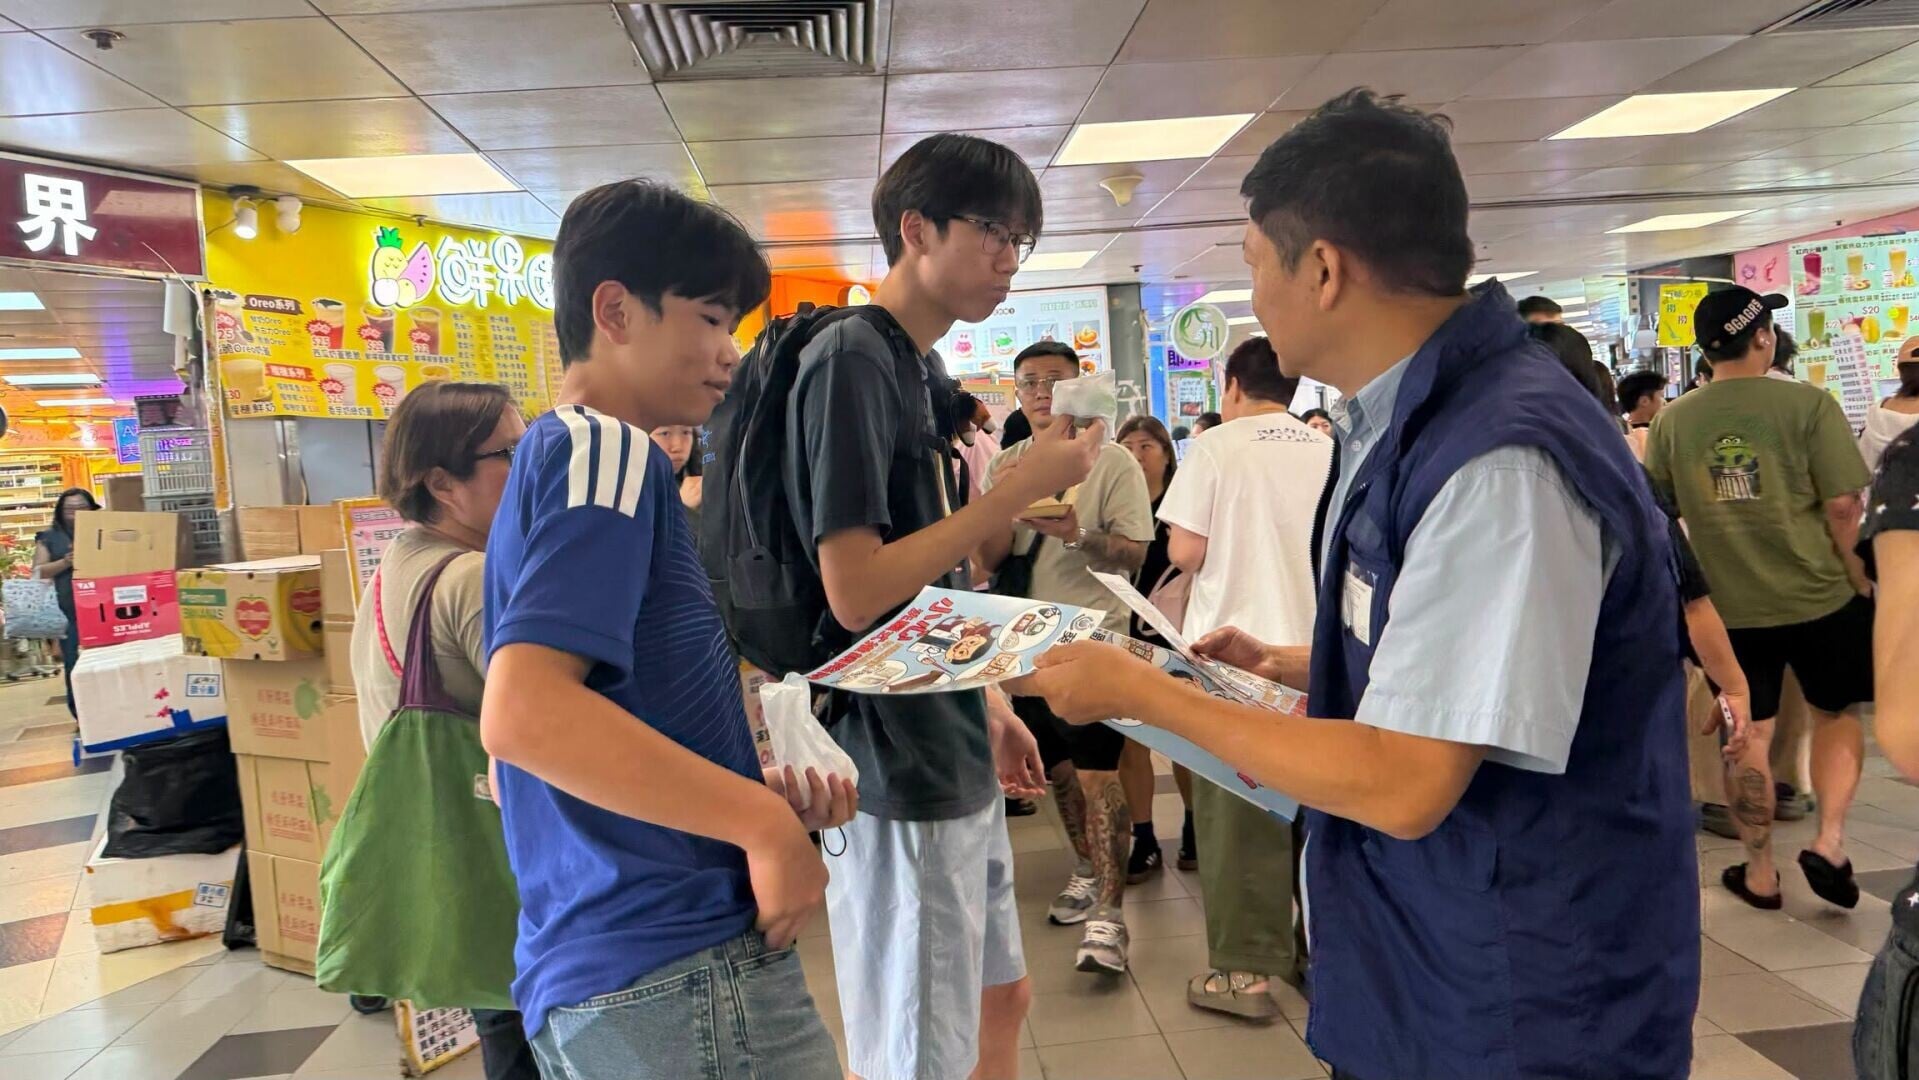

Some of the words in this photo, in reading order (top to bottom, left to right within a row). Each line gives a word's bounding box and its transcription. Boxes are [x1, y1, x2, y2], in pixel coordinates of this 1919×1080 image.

[17, 173, 97, 256] 界
[1862, 306, 1880, 315] $20
[112, 621, 152, 634] APPLES
[897, 597, 954, 642] 小心
